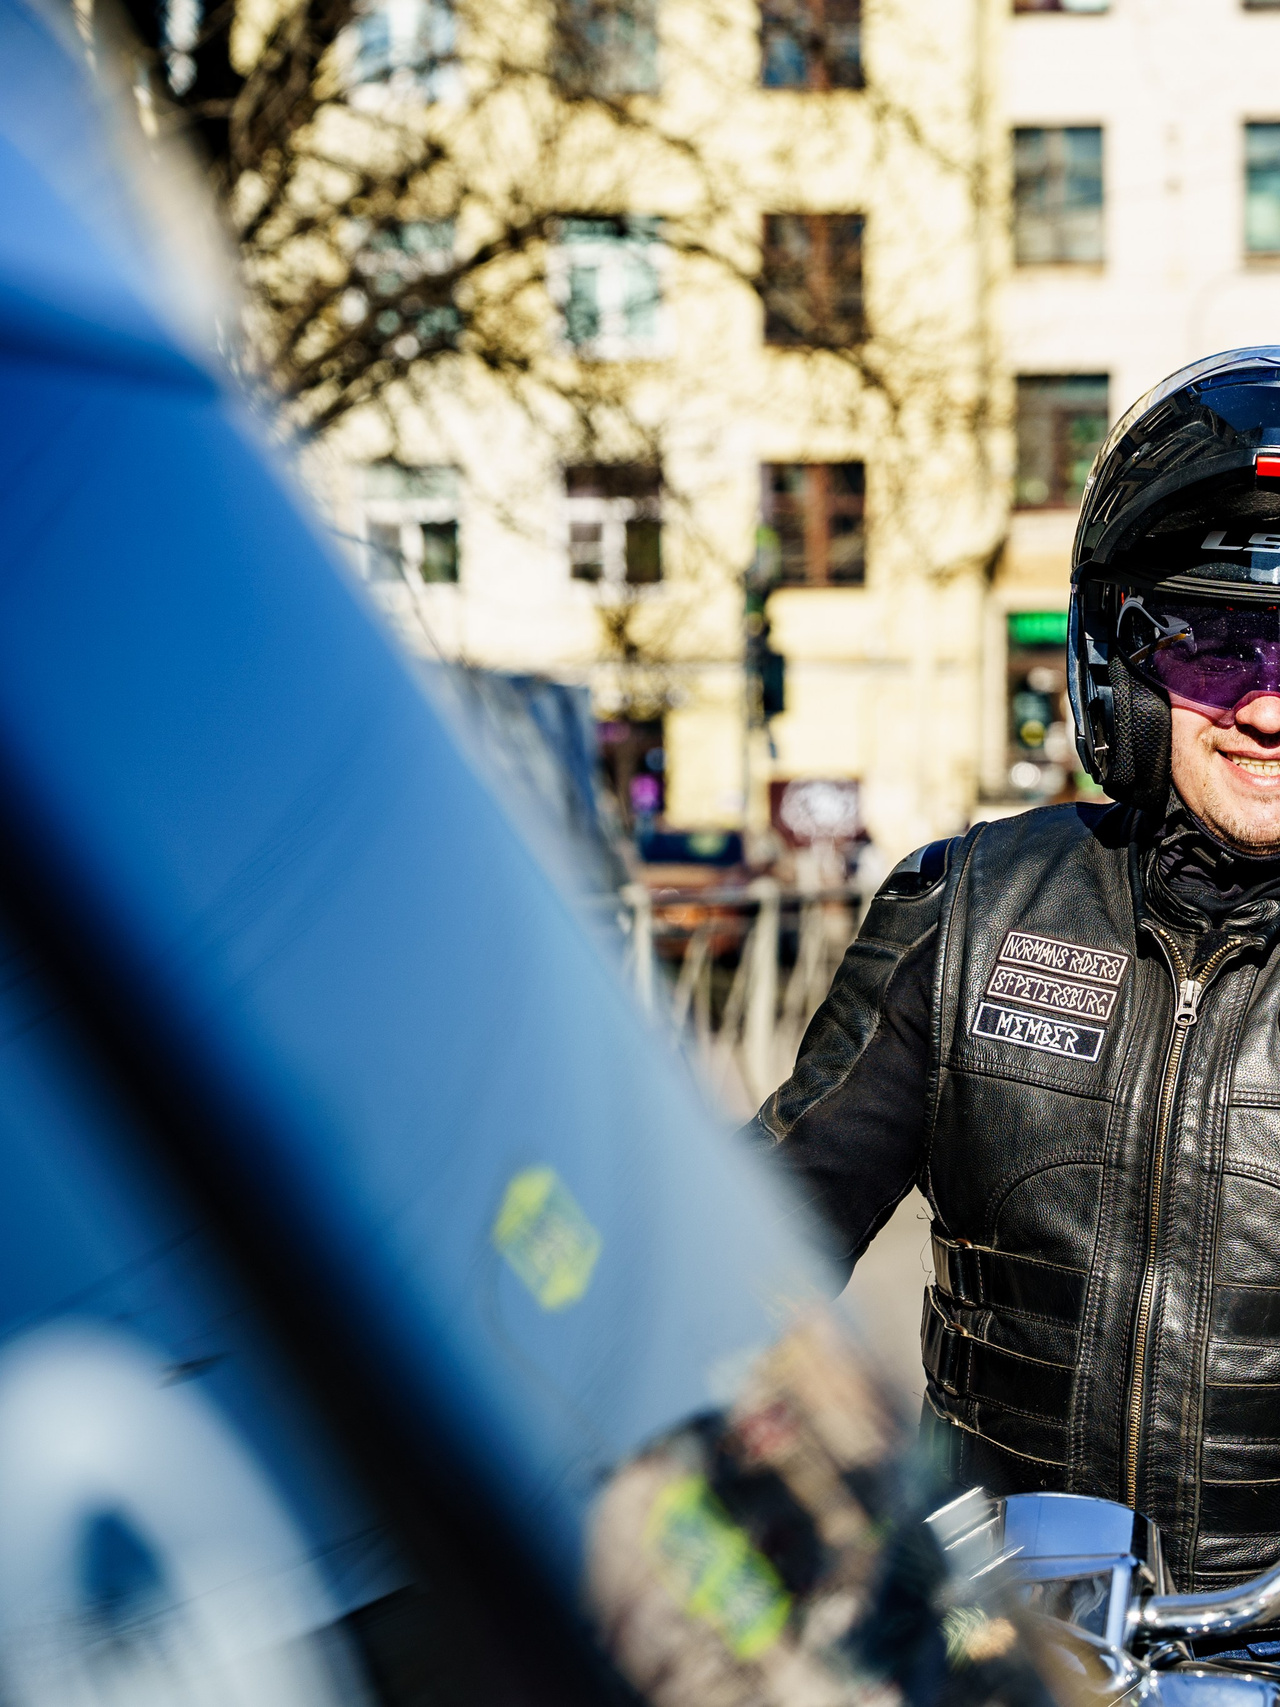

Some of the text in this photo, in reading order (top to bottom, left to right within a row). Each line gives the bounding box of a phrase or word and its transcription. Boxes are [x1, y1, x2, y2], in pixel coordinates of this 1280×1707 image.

[1006, 936, 1121, 979] NORMANS RIDERS
[995, 1012, 1079, 1054] MEMBER
